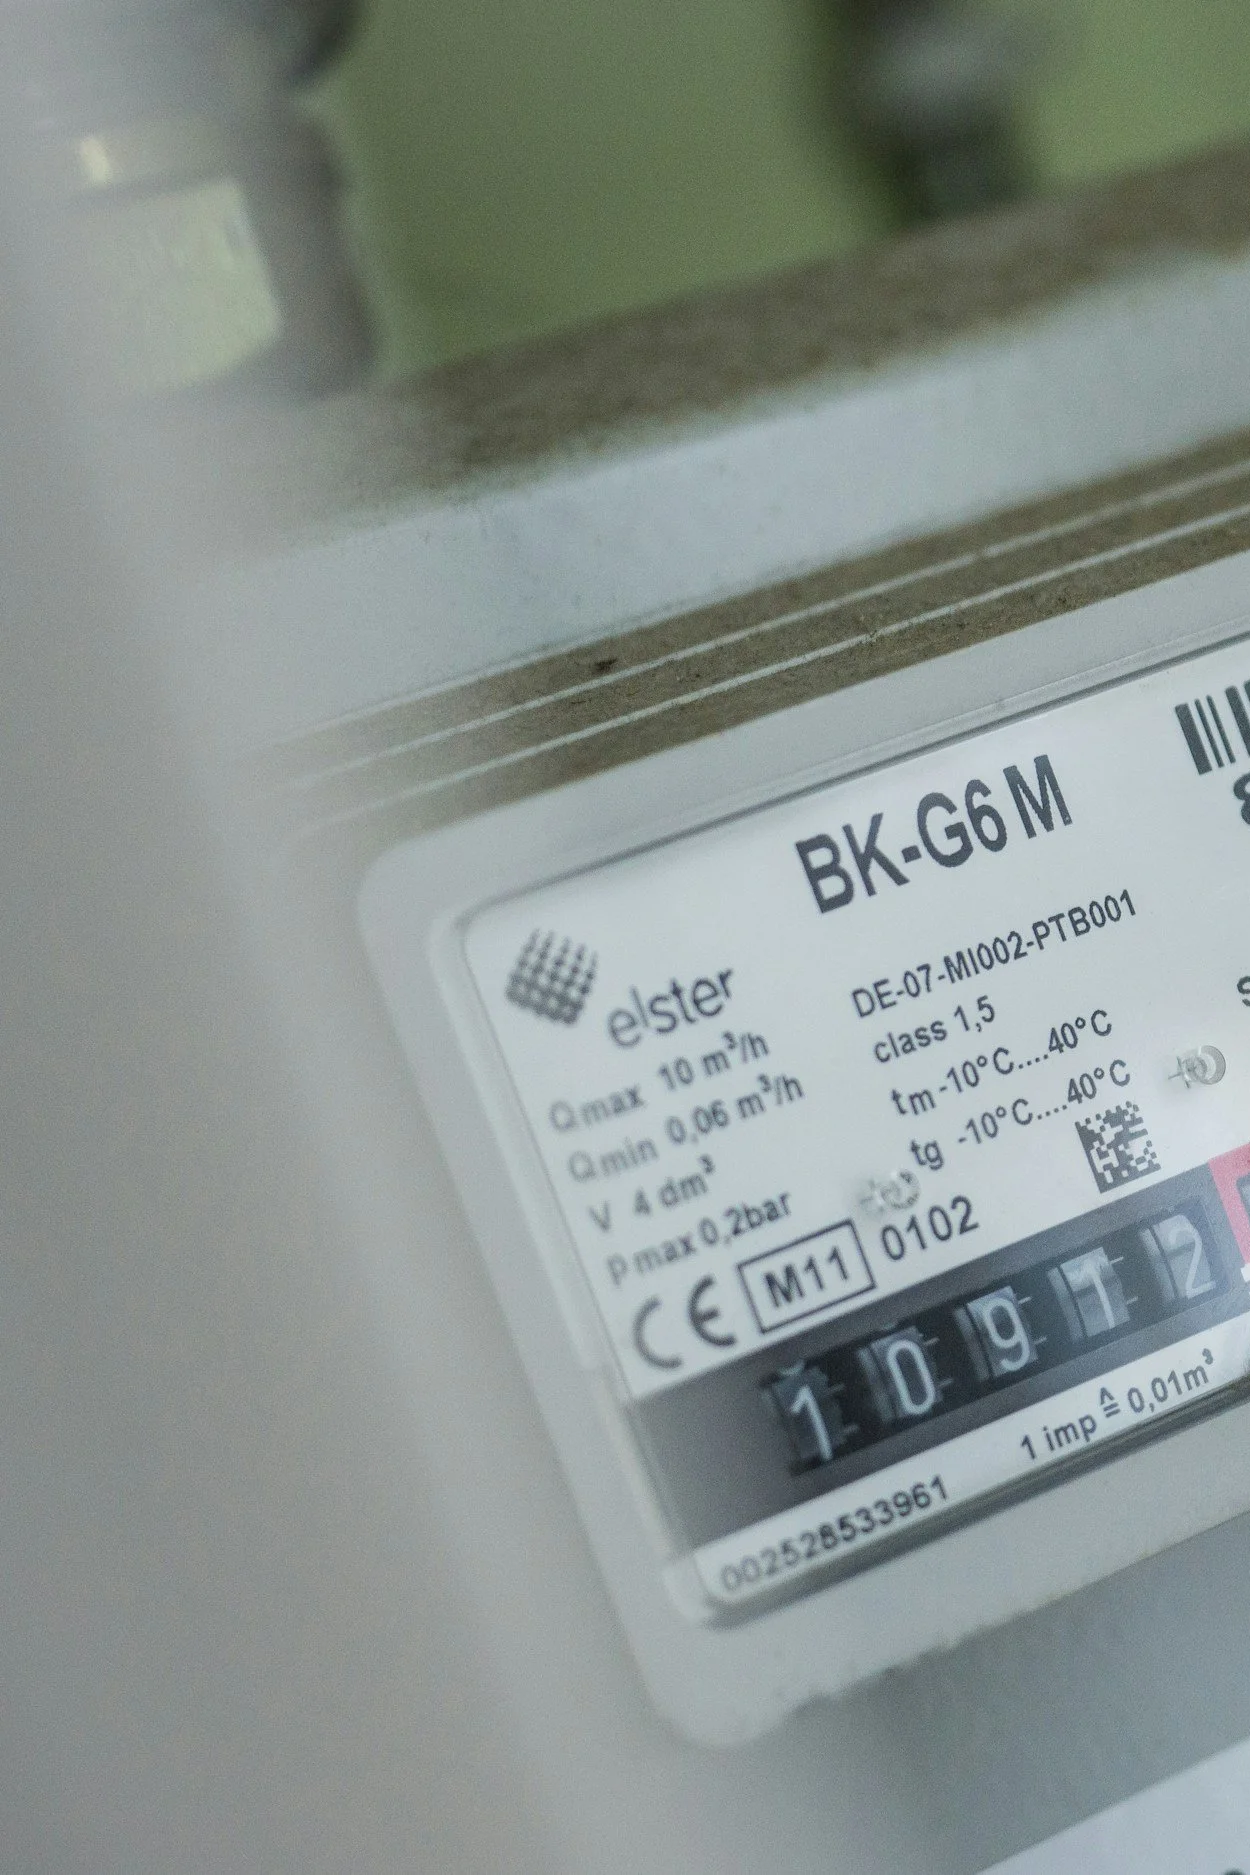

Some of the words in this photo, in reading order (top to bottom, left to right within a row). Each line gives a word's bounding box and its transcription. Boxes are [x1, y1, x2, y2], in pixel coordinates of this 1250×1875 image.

[795, 779, 1008, 914] BK-G6
[1003, 754, 1073, 839] M
[852, 889, 1137, 1018] DE-07-MI002-PTB001
[607, 968, 735, 1049] elster
[874, 1018, 948, 1064] class
[954, 994, 996, 1034] 1,5
[657, 1056, 694, 1091] 10
[665, 1099, 730, 1145] 0,06
[910, 1139, 944, 1171] tg
[588, 1200, 612, 1233] V
[633, 1186, 652, 1217] 4
[881, 1194, 980, 1261] 0102
[1021, 1434, 1036, 1461] 1
[1046, 1411, 1098, 1454] imp
[719, 1474, 949, 1593] 002528533961
